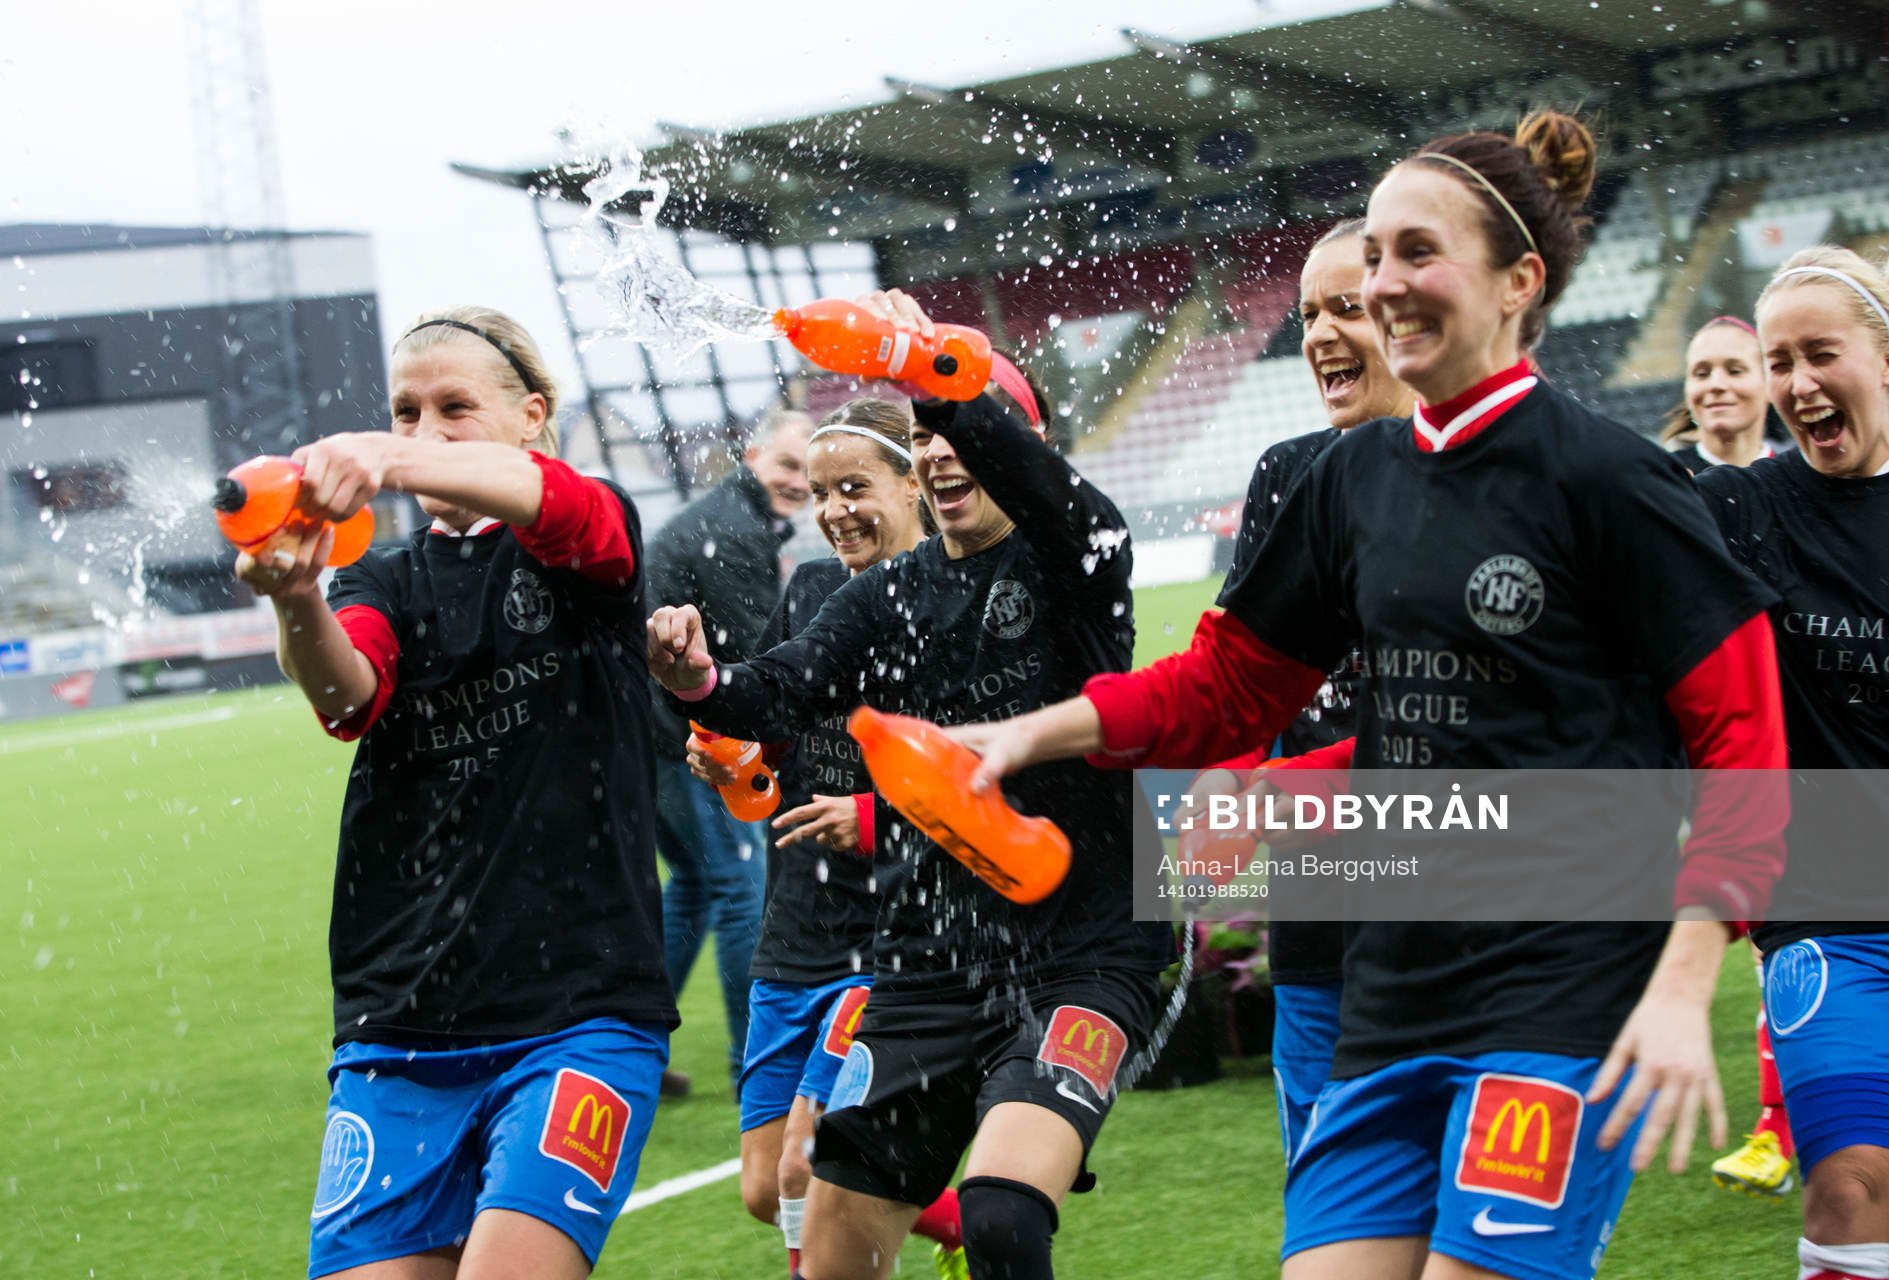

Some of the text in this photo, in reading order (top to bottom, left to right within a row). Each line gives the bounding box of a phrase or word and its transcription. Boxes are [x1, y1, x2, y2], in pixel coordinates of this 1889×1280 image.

[1783, 612, 1889, 639] CHAM
[1848, 683, 1889, 703] 20
[802, 735, 861, 764] LEAGU
[815, 763, 855, 789] 2015
